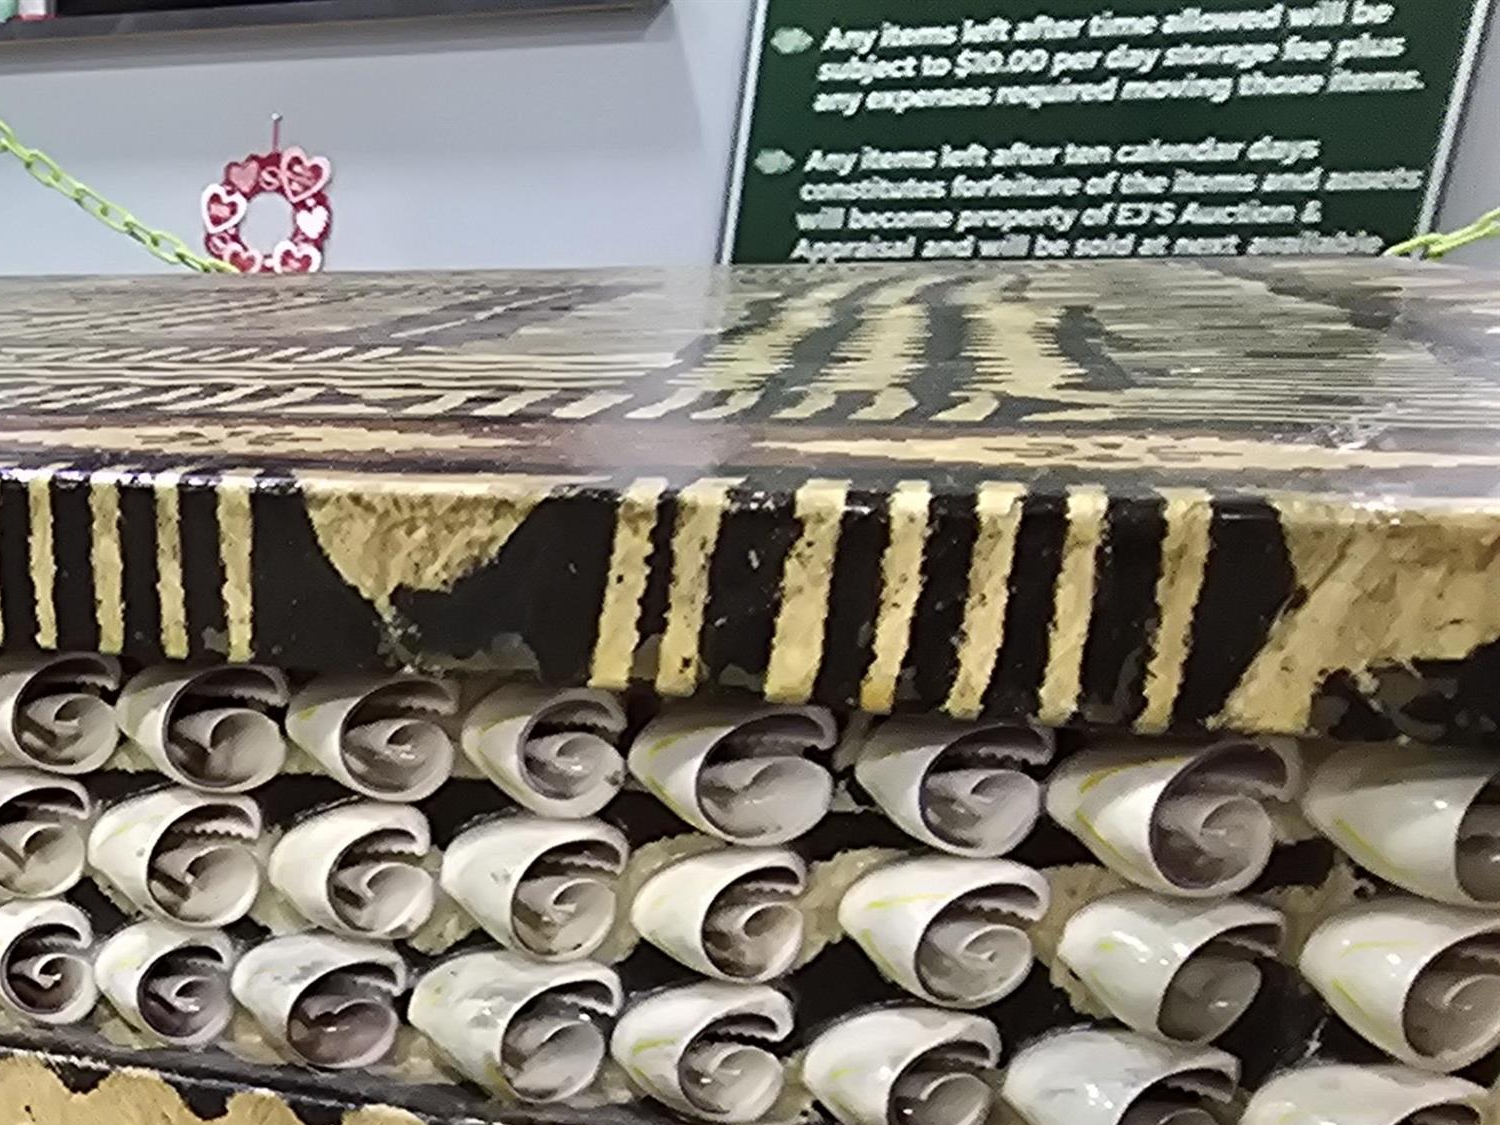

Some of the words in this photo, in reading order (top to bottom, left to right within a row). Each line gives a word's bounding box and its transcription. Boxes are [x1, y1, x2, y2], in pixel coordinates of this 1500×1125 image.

[820, 26, 878, 54] Any
[879, 21, 958, 47] items
[960, 17, 1011, 44] left
[1013, 15, 1087, 40] after
[1087, 10, 1157, 36] time
[1161, 4, 1284, 33] allowed
[1287, 0, 1347, 27] will
[1350, 1, 1395, 24] be
[816, 53, 918, 85] subject
[920, 54, 952, 77] to
[1049, 49, 1102, 77] per
[1103, 43, 1161, 73] day
[1161, 43, 1279, 69] storage
[1281, 35, 1333, 61] fee
[1332, 32, 1406, 66] plus
[813, 92, 863, 117] any
[864, 86, 994, 114] expenses
[995, 77, 1119, 109] required
[1119, 71, 1233, 103] moving
[1236, 71, 1326, 96] those
[803, 150, 858, 176] Any
[858, 146, 937, 171] items
[938, 144, 988, 168] left
[989, 142, 1063, 167] after
[1062, 143, 1112, 165] ten
[1115, 137, 1246, 164] calendar
[1247, 136, 1322, 166] days
[800, 175, 948, 200] constitutes
[949, 173, 1082, 198] forfeiture
[1082, 171, 1120, 195] of
[1119, 169, 1171, 194] the
[1170, 168, 1257, 193] items
[1260, 167, 1324, 192] and
[795, 206, 846, 230] will
[847, 207, 954, 230] become
[953, 205, 1079, 233] property
[1079, 202, 1116, 226] of
[1176, 199, 1297, 226] Auction
[1300, 200, 1323, 225] &
[790, 236, 917, 263] Appraisal
[920, 234, 976, 257] and
[977, 233, 1032, 257] will
[1033, 234, 1071, 258] be
[1073, 233, 1137, 257] sold
[1137, 235, 1171, 255] at
[1173, 234, 1242, 256] next
